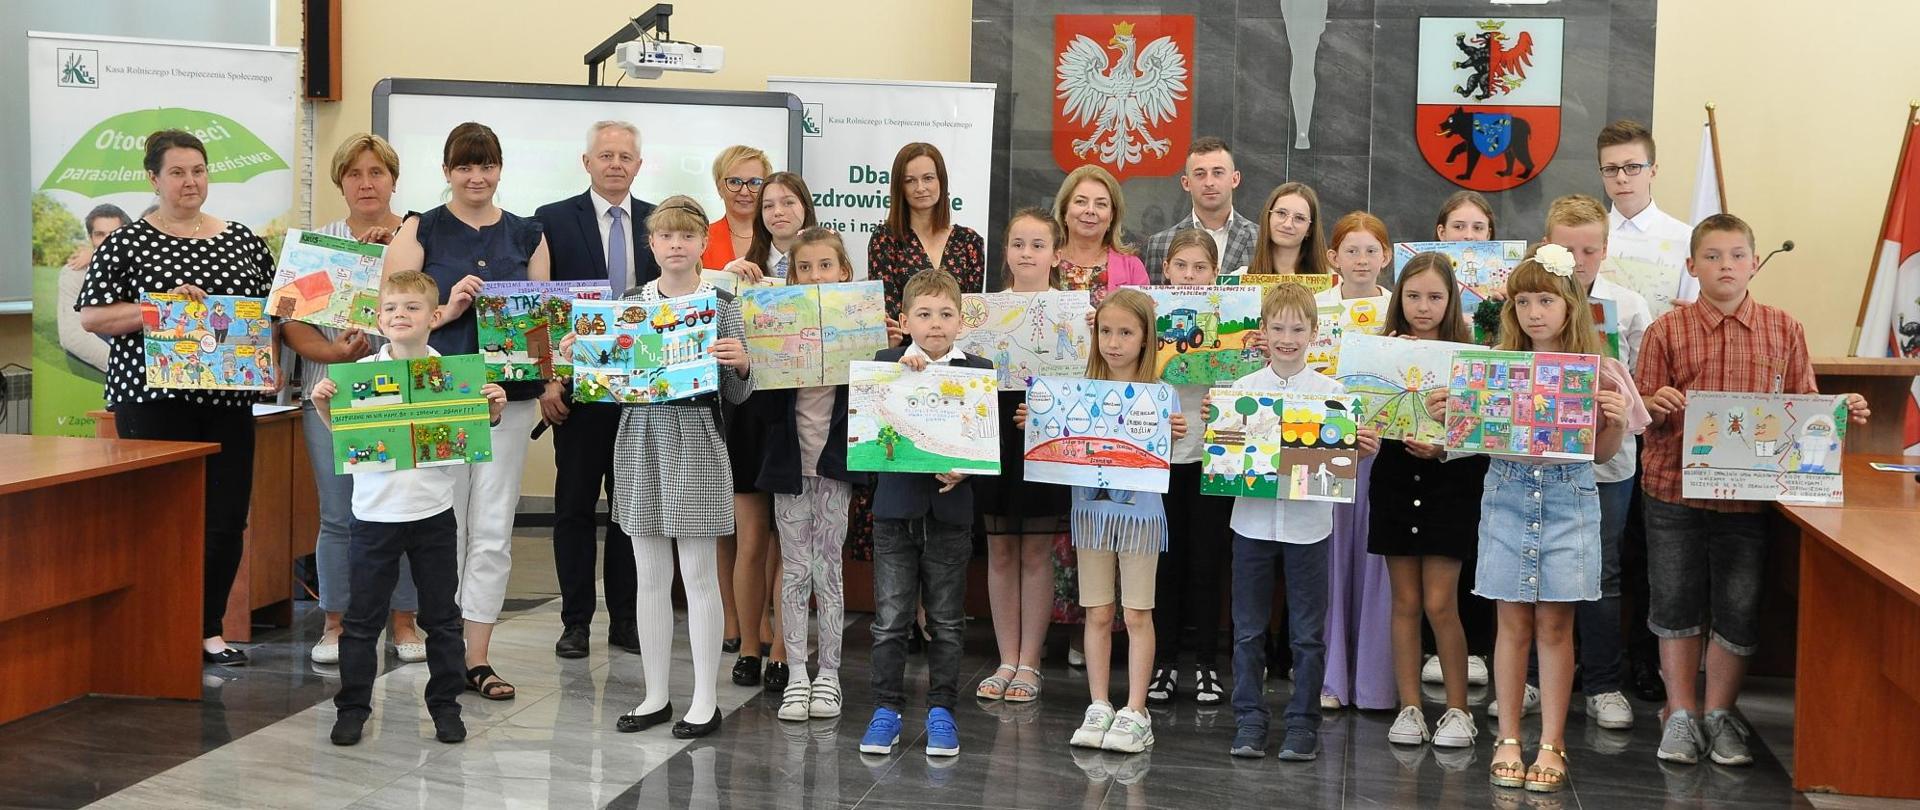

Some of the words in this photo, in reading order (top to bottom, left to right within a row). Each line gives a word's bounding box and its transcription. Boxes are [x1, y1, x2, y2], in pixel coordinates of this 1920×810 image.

[105, 65, 125, 75] Kasa
[126, 66, 169, 78] Rolniczego
[171, 68, 225, 79] Ubezpieczenia
[227, 71, 273, 83] Społecznego
[828, 116, 845, 125] Kasa
[846, 117, 883, 127] Rolniczego
[884, 118, 931, 128] Ubezpieczenia
[95, 128, 147, 151] Otoc
[56, 166, 148, 183] parasolem
[813, 188, 892, 209] zdrowie
[851, 219, 855, 233] i
[510, 294, 541, 310] TAK
